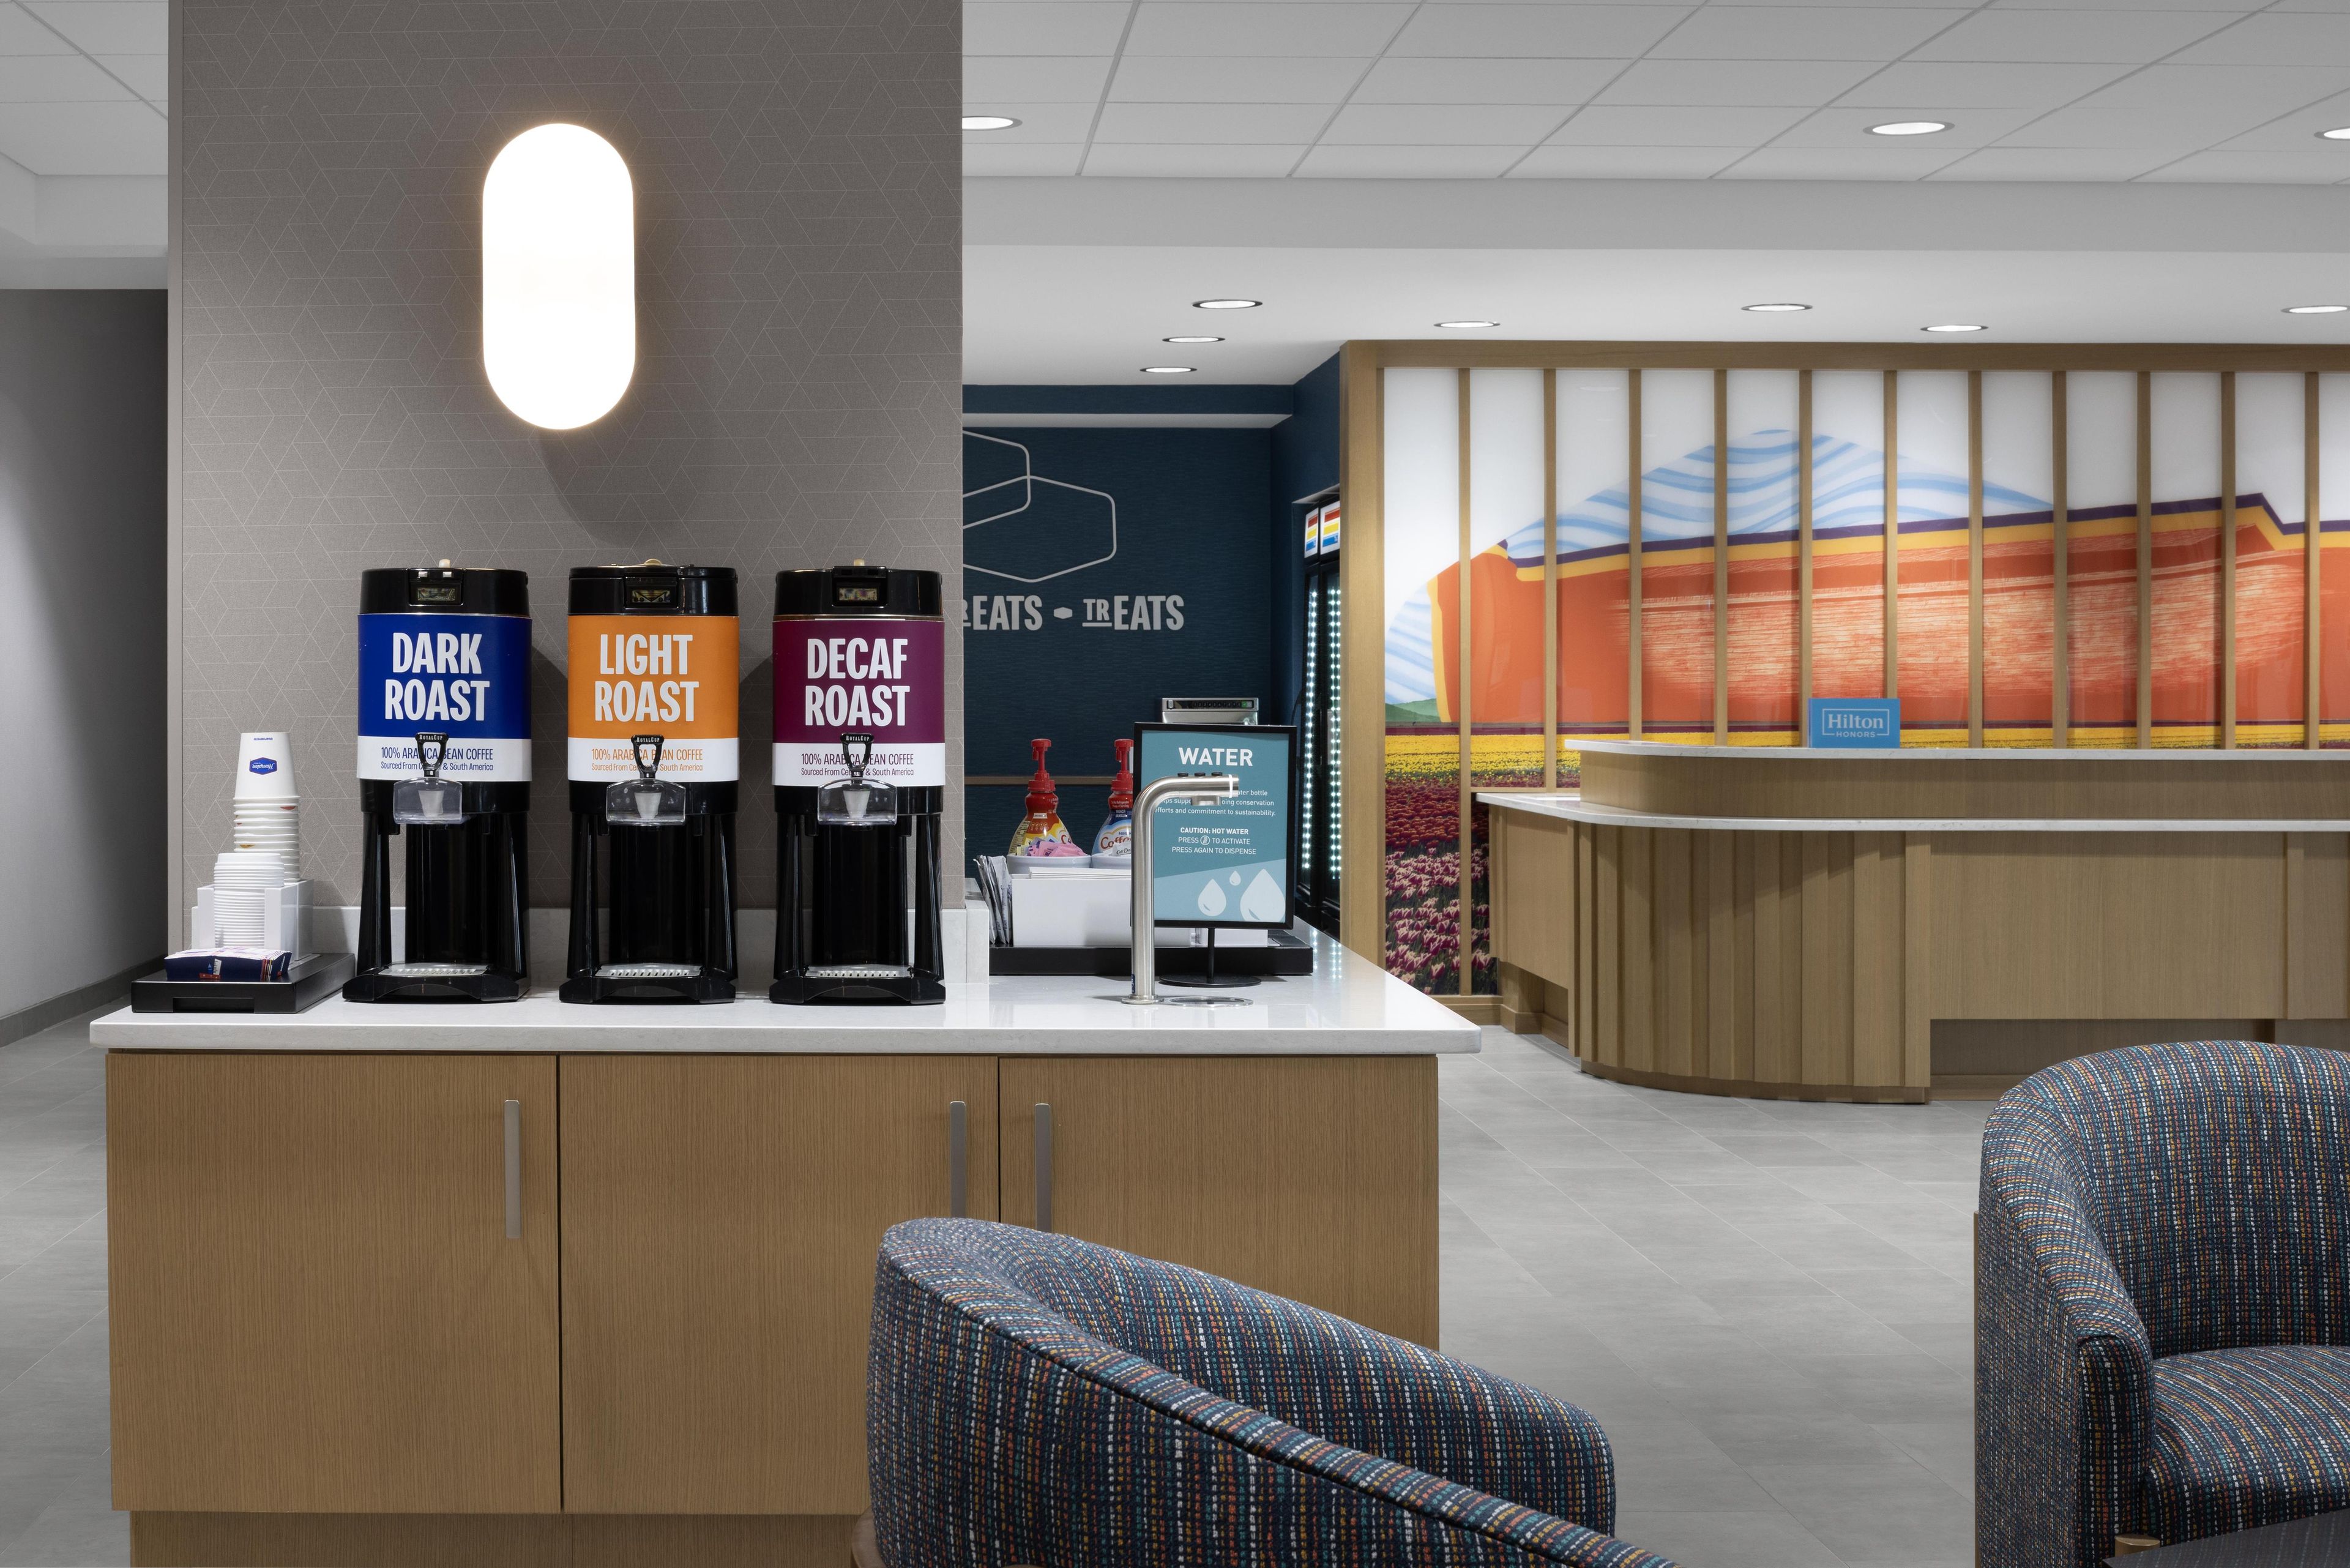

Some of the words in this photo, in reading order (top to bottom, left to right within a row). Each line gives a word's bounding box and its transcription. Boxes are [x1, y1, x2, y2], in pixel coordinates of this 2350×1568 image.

[1083, 594, 1185, 631] TREATS
[392, 632, 483, 674] DARK
[599, 633, 693, 676] LIGHT
[807, 638, 909, 679] DECAF
[384, 678, 491, 722] ROAST
[594, 681, 699, 722] ROAST
[804, 684, 911, 726] ROAST
[1828, 714, 1884, 729] Hilton
[381, 747, 400, 759] 100%
[402, 747, 439, 760] ARAICA
[466, 749, 493, 760] COFFEE
[592, 749, 611, 760] 100%
[613, 749, 649, 760] ARABCA
[651, 749, 674, 760] BAN
[676, 749, 703, 760] COFFEE
[801, 753, 821, 765] 100%
[824, 753, 860, 765] ARABCA
[867, 754, 886, 765] EAN
[889, 754, 914, 765] COFFEE
[1179, 747, 1253, 766] WATER
